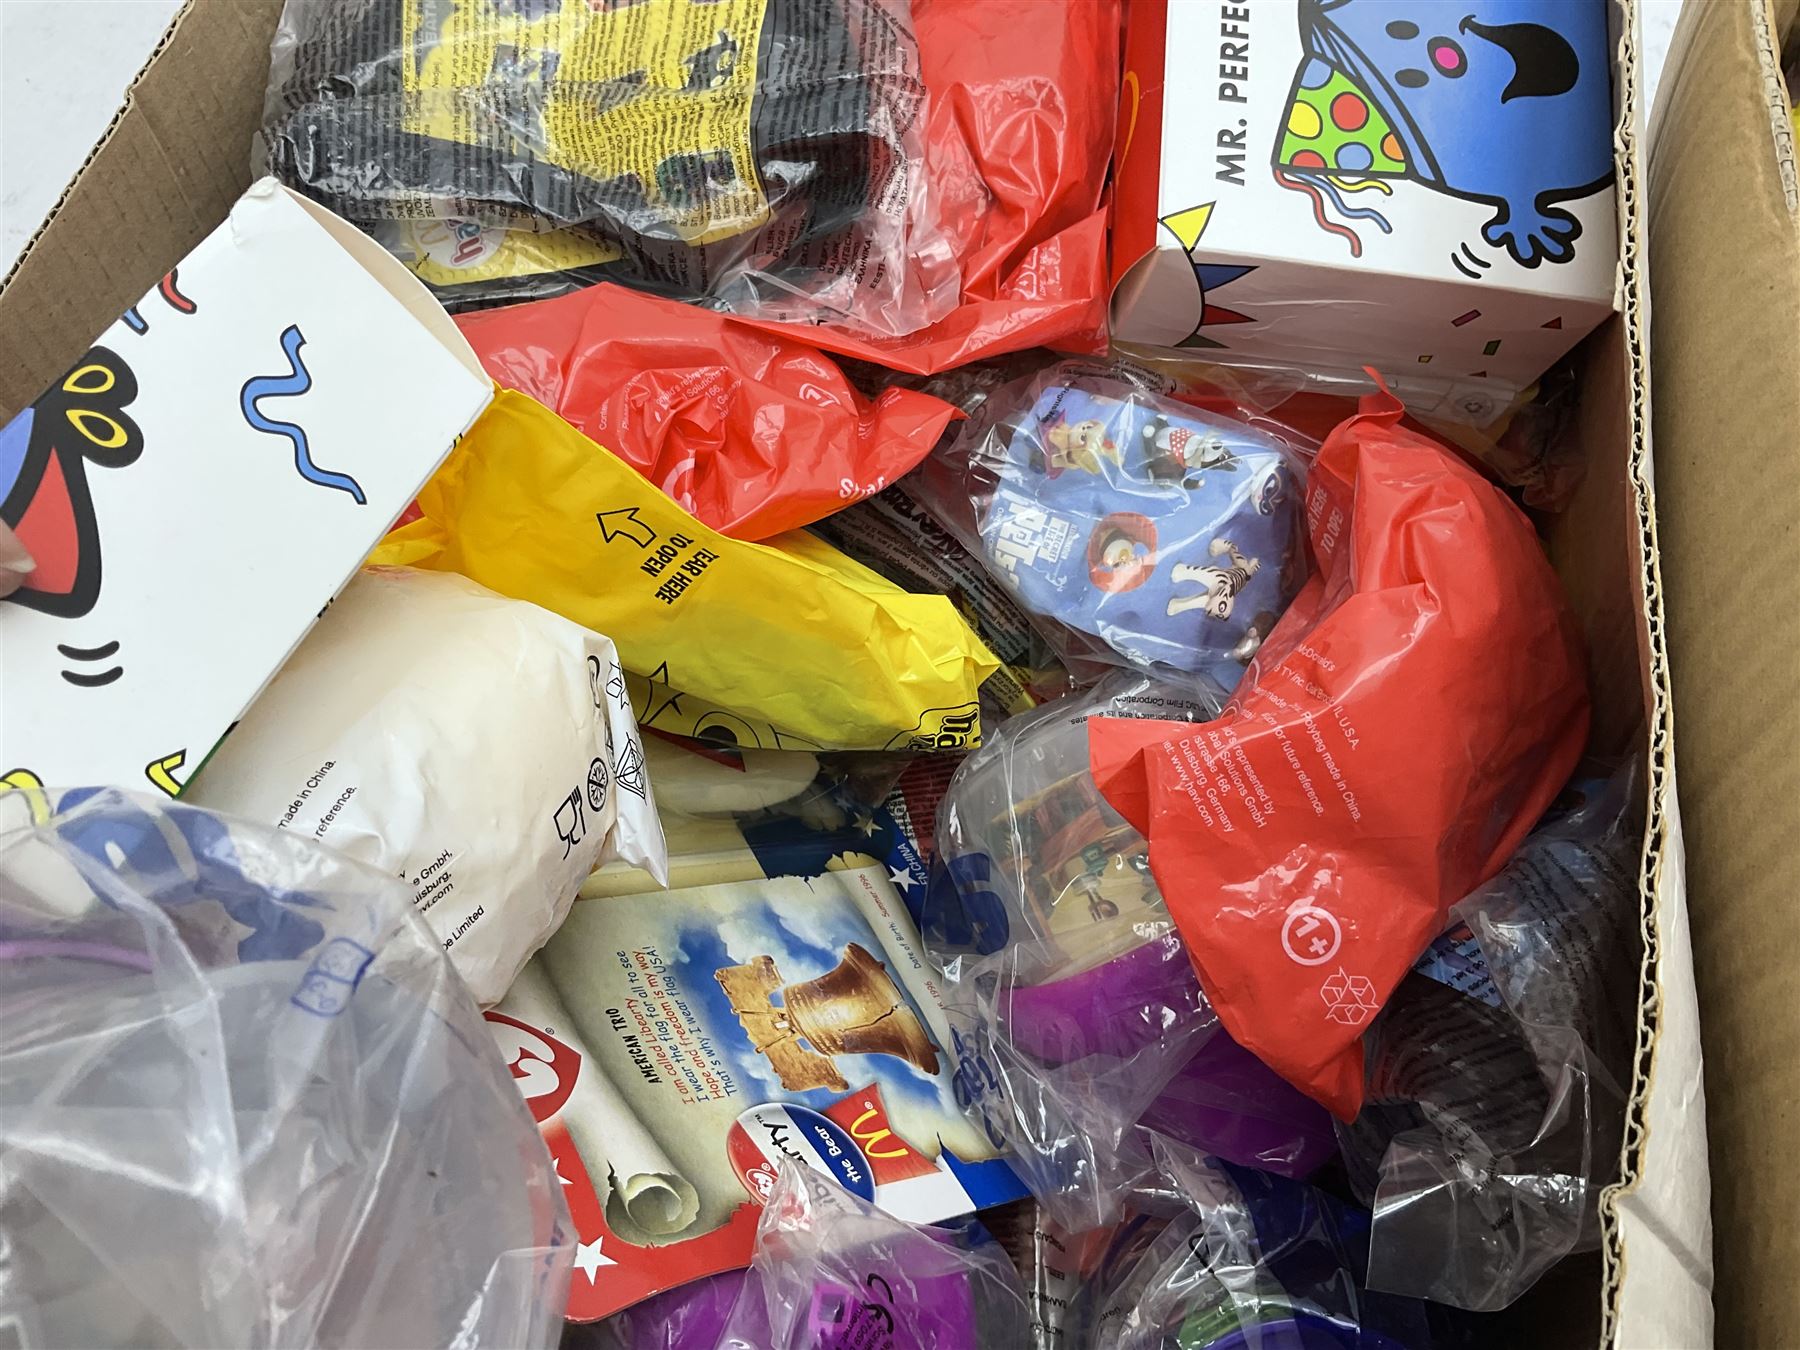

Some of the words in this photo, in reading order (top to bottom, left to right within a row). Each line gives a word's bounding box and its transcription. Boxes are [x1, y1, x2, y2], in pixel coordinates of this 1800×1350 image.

[1213, 117, 1249, 186] MR.
[869, 262, 886, 289] EESTI
[668, 527, 694, 553] TO
[1049, 533, 1063, 561] SECRET
[1317, 533, 1337, 553] TO
[639, 539, 679, 580] OPEN
[680, 541, 720, 582] TEAR
[653, 567, 692, 608] HERE
[1114, 692, 1164, 707] Corporation
[1165, 698, 1184, 708] Film
[1297, 709, 1329, 754] Polybag
[297, 785, 312, 800] in
[305, 757, 337, 790] China.
[1230, 743, 1269, 804] represented
[1260, 801, 1276, 817] by
[1280, 738, 1304, 770] future
[1294, 767, 1327, 817] reference.
[1320, 750, 1343, 781] made
[1168, 753, 1215, 829] www.havi.com
[1176, 738, 1211, 790] Duisburg,
[1202, 786, 1235, 835] Germany
[1212, 772, 1232, 797] 166,
[1217, 749, 1250, 798] Solutions
[1242, 795, 1267, 829] GmbH
[1335, 779, 1349, 792] in
[312, 780, 357, 838] reference.
[1340, 789, 1364, 823] China.
[418, 847, 453, 880] GmbH,
[897, 841, 922, 872] CHINA
[857, 871, 872, 891] 1996
[868, 889, 890, 918] Summer
[451, 904, 485, 940] Limited
[886, 920, 904, 943] Birth:
[613, 948, 634, 972] see
[630, 946, 652, 972] way
[641, 941, 669, 976] USA!
[899, 940, 910, 952] of
[906, 949, 921, 970] Date
[624, 968, 640, 984] to
[642, 969, 660, 989] my
[658, 972, 683, 999] flag
[923, 979, 940, 1000] 1996
[630, 981, 649, 1001] all
[650, 987, 666, 1002] is
[603, 1004, 628, 1033] TRIO
[620, 993, 661, 1046] Libearty
[639, 998, 660, 1021] for
[656, 999, 694, 1049] freedom
[672, 996, 697, 1026] wear
[650, 1016, 676, 1045] flag
[688, 1023, 702, 1037] I
[619, 1030, 664, 1088] AMERICAN
[665, 1042, 686, 1065] the
[685, 1047, 706, 1072] and
[694, 1032, 718, 1059] why
[649, 1042, 678, 1079] called
[672, 1076, 689, 1096] am
[679, 1063, 704, 1094] wear
[699, 1067, 727, 1102] Hope
[707, 1056, 739, 1097] That's
[681, 1093, 695, 1107] I
[696, 1091, 709, 1105] I
[813, 1122, 842, 1157] Bear
[840, 1155, 863, 1184] the
